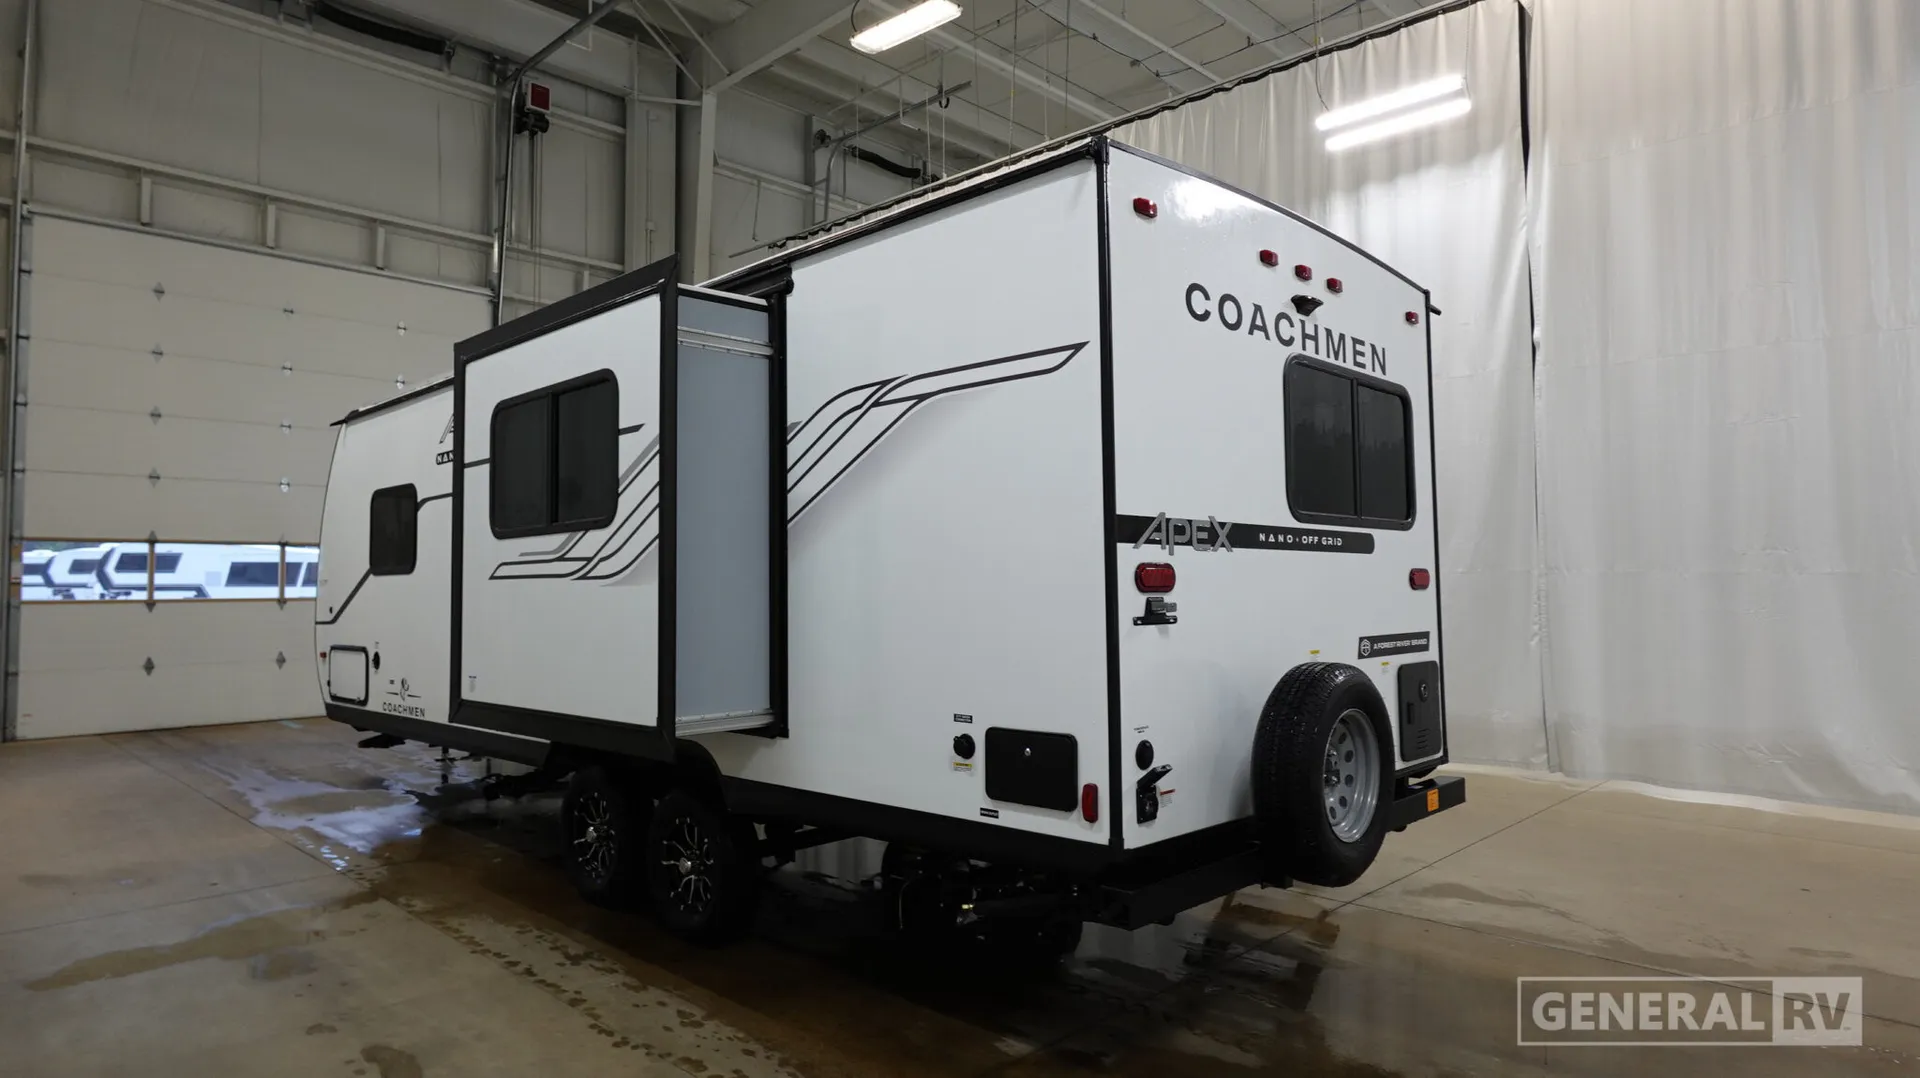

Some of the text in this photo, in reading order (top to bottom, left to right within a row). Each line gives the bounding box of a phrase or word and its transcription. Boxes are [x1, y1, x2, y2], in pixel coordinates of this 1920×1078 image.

[1185, 282, 1388, 376] COACHMEN
[437, 452, 454, 464] NAN
[1132, 511, 1234, 556] APEX
[1259, 532, 1343, 546] NANO OFF GRID
[1378, 641, 1396, 649] FOREST
[382, 701, 426, 718] COACHMEN
